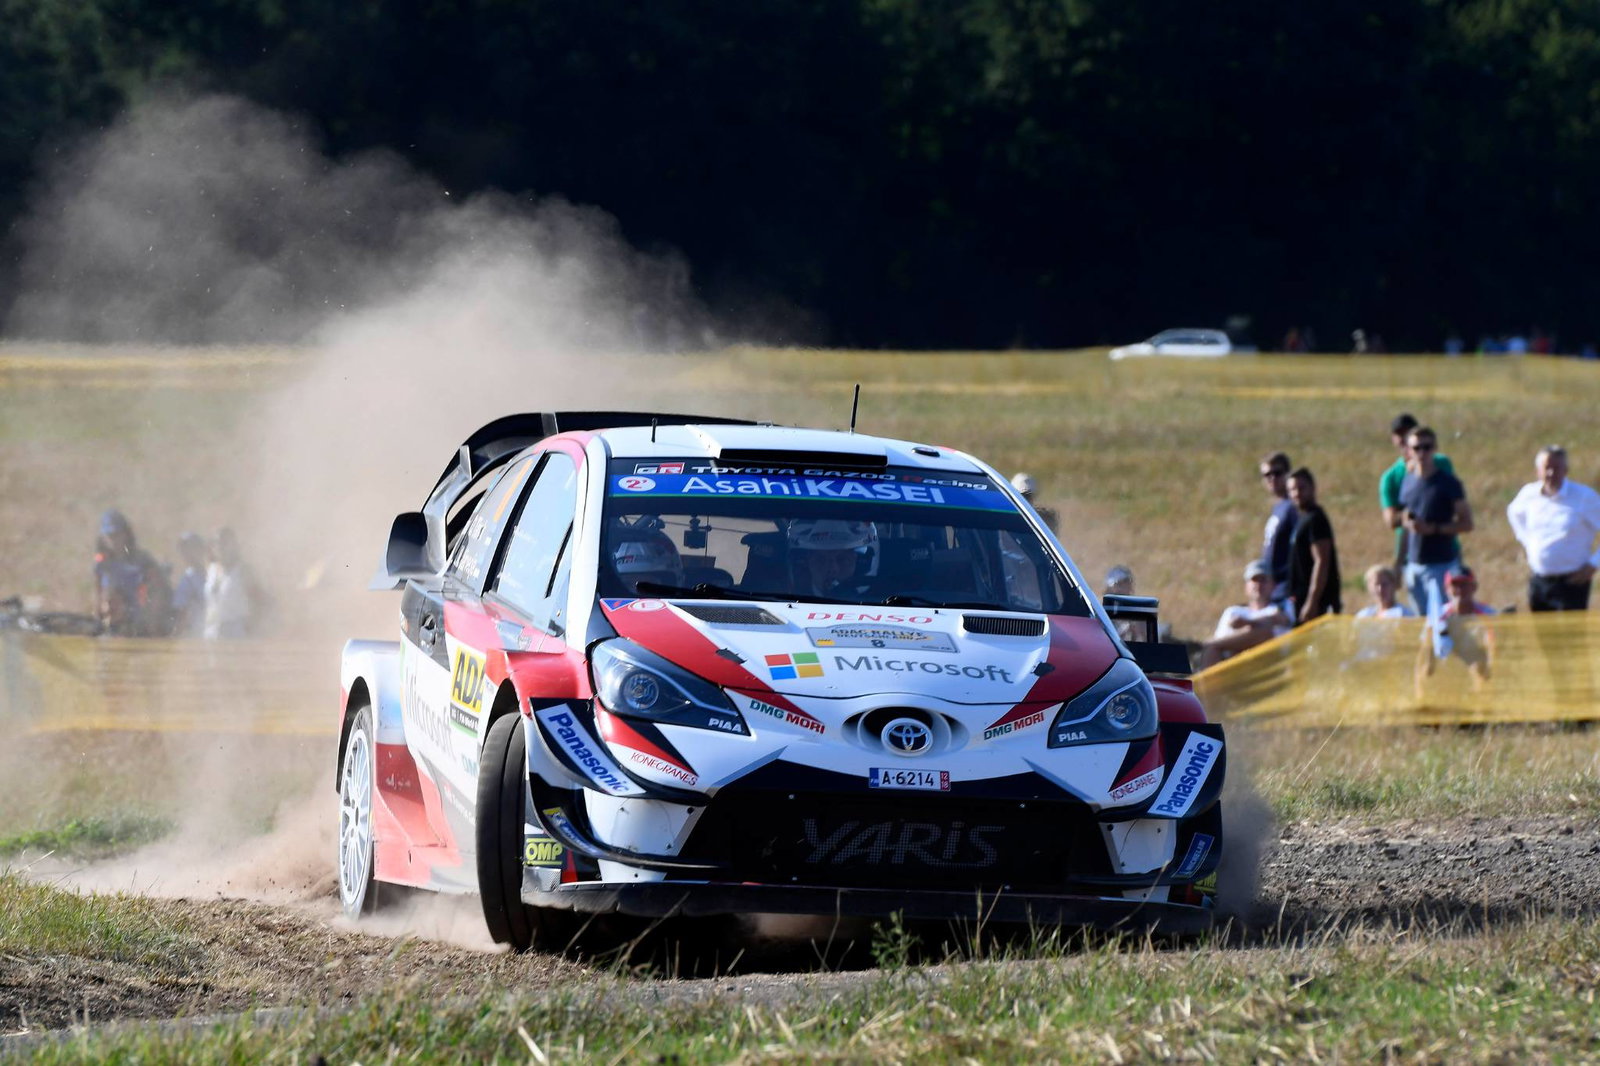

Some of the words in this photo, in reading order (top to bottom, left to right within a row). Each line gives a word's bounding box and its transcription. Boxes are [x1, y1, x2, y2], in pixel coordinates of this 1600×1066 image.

[692, 465, 796, 475] TOYOTA
[803, 468, 896, 481] GAZOO
[902, 475, 988, 491] Racing
[807, 612, 933, 624] DENSO
[871, 639, 886, 648] 8
[834, 655, 1014, 684] Microsoft
[708, 717, 742, 733] PIAA
[749, 700, 784, 719] DMG
[785, 712, 826, 735] MORI
[983, 723, 1012, 740] DMG
[1013, 712, 1044, 732] MORI
[1058, 731, 1088, 742] PIAA
[548, 712, 629, 792] Panasonic
[1155, 741, 1214, 814] Panasonic
[525, 842, 563, 861] OMP
